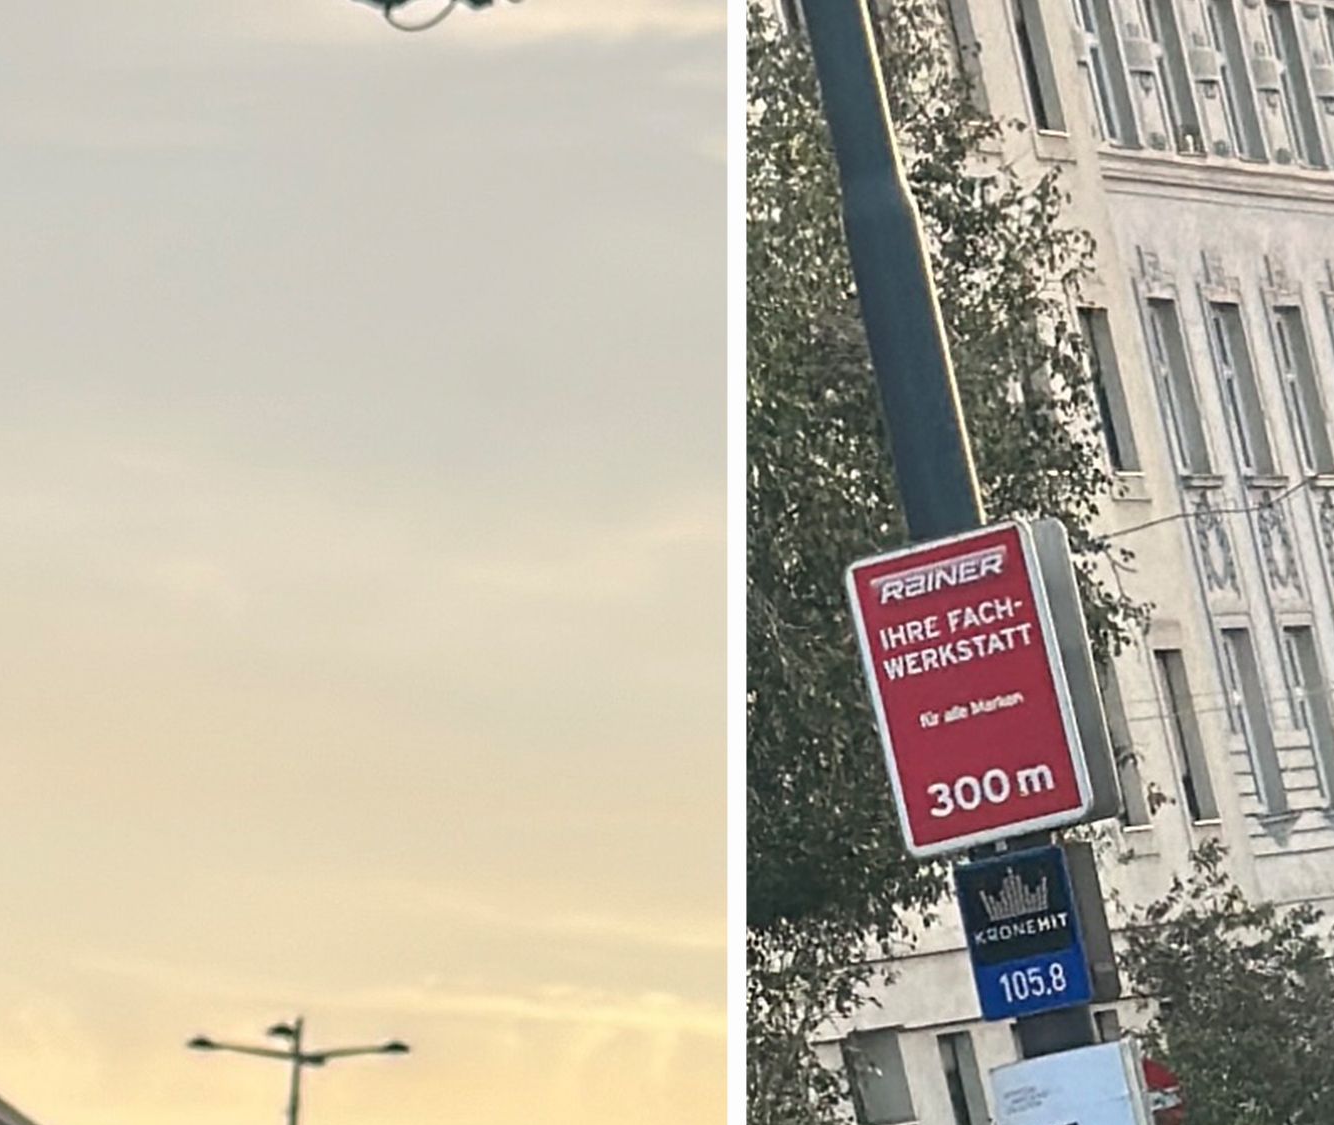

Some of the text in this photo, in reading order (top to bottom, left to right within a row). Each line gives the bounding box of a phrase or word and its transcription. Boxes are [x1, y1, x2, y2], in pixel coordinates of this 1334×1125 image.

[880, 597, 1023, 650] IHRE FACH-
[883, 623, 1032, 681] WERKSTATT
[920, 692, 1024, 728] für alle Marken
[927, 764, 1055, 817] 300 m
[974, 912, 1068, 945] KRONEHIT
[999, 962, 1066, 1002] 105.8
